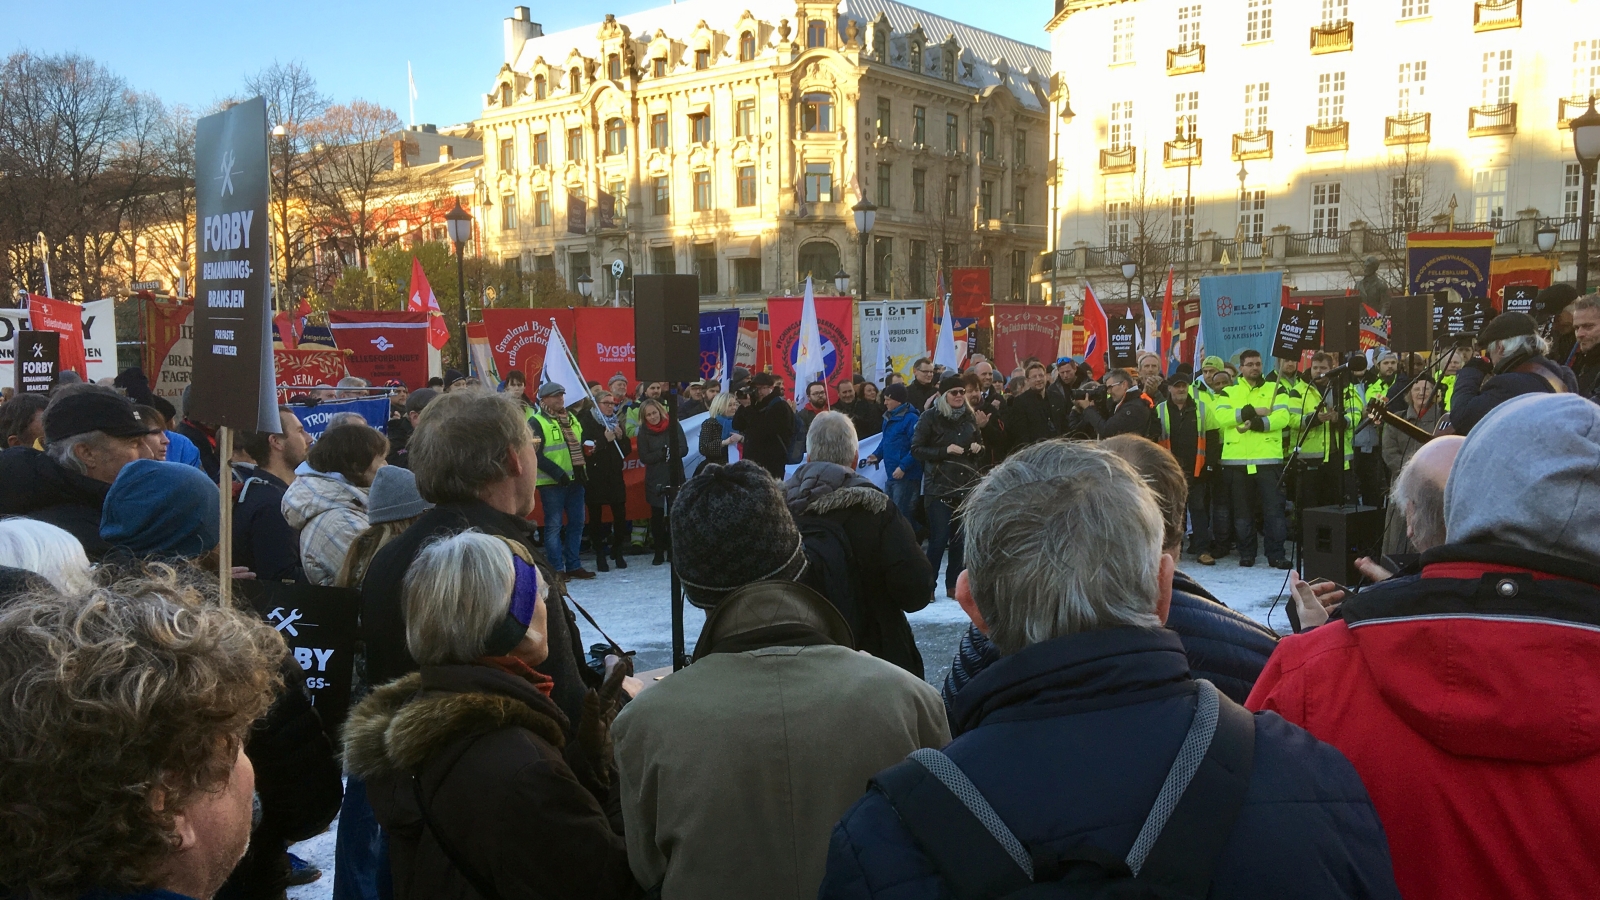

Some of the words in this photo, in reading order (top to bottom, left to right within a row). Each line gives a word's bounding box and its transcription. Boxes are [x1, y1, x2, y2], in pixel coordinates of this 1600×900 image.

[204, 210, 254, 252] FORBY
[203, 260, 253, 280] BEMANNINGS-
[208, 290, 244, 308] BRANSJEN
[1281, 324, 1304, 334] FORBY
[495, 321, 529, 353] Grenland
[532, 321, 550, 338] Byg
[23, 362, 54, 374] FORBY
[168, 355, 193, 367] BRAN
[292, 374, 314, 386] JERN
[303, 412, 333, 427] TROM
